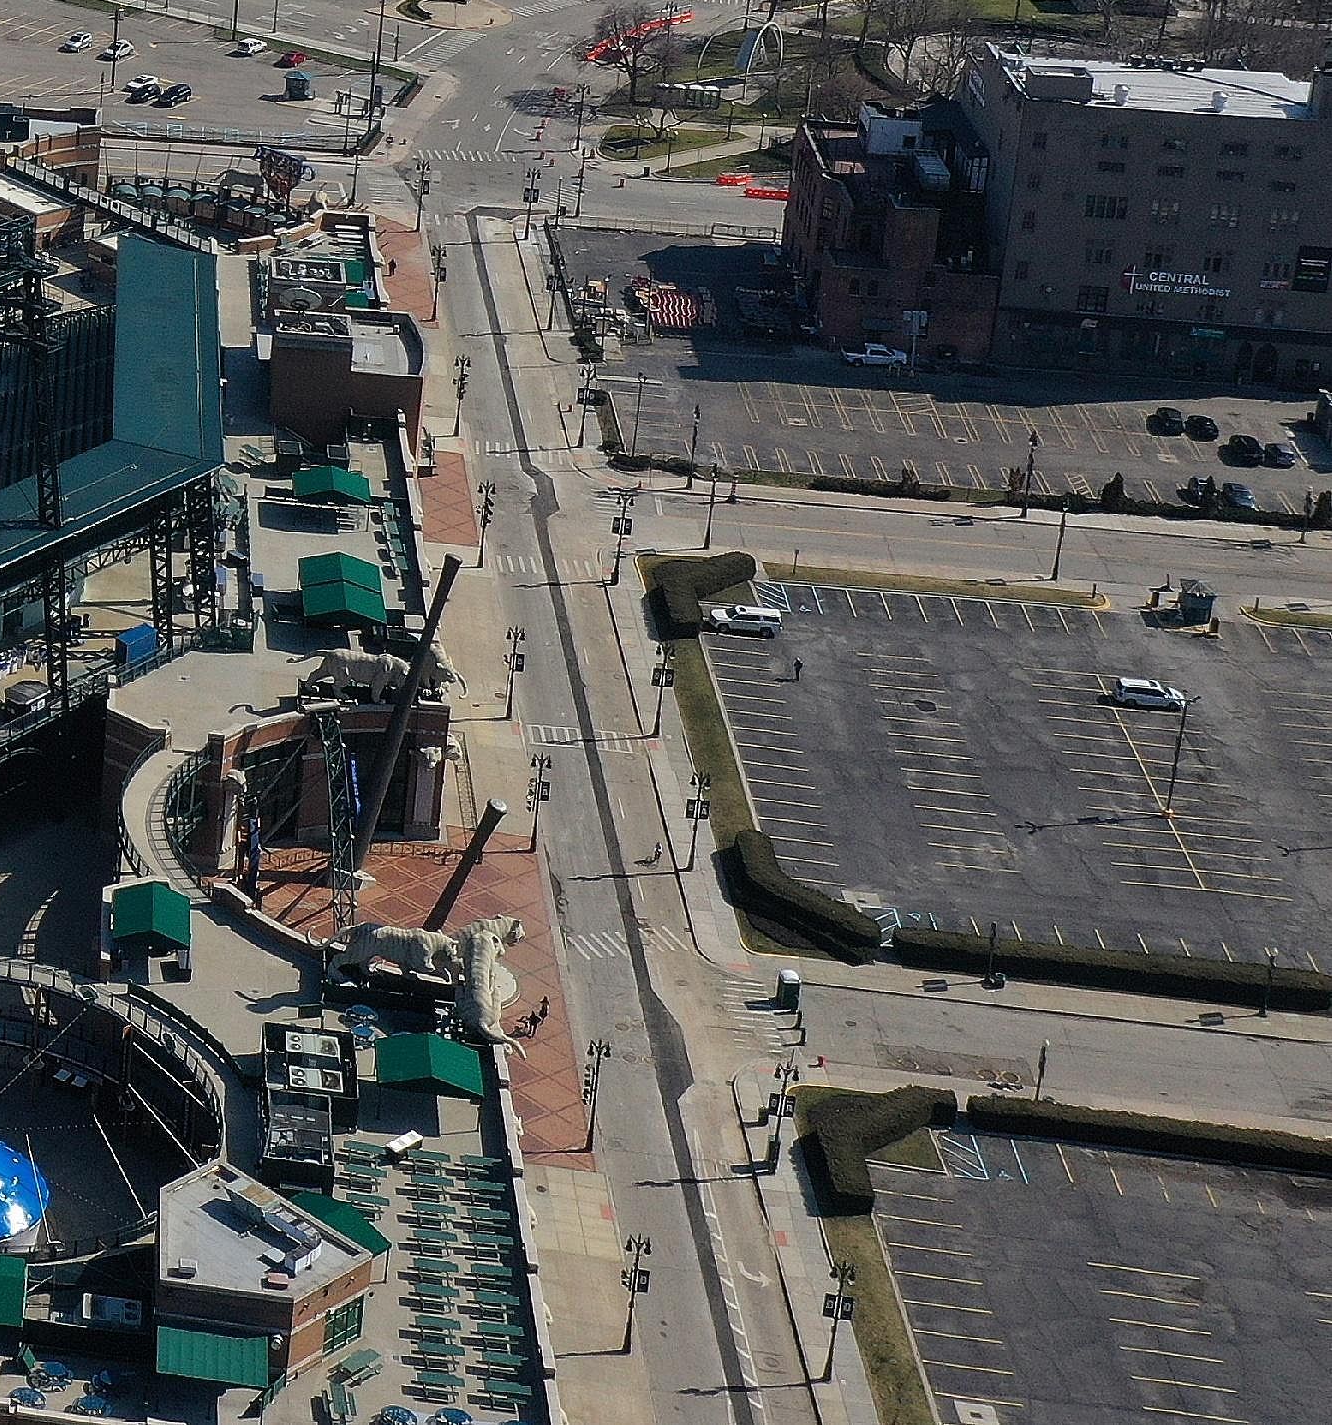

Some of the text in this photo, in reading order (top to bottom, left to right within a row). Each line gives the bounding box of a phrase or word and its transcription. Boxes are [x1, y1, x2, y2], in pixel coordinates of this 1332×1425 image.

[1149, 271, 1210, 285] CENTRAL
[1135, 283, 1231, 298] UNITED METHODIST
